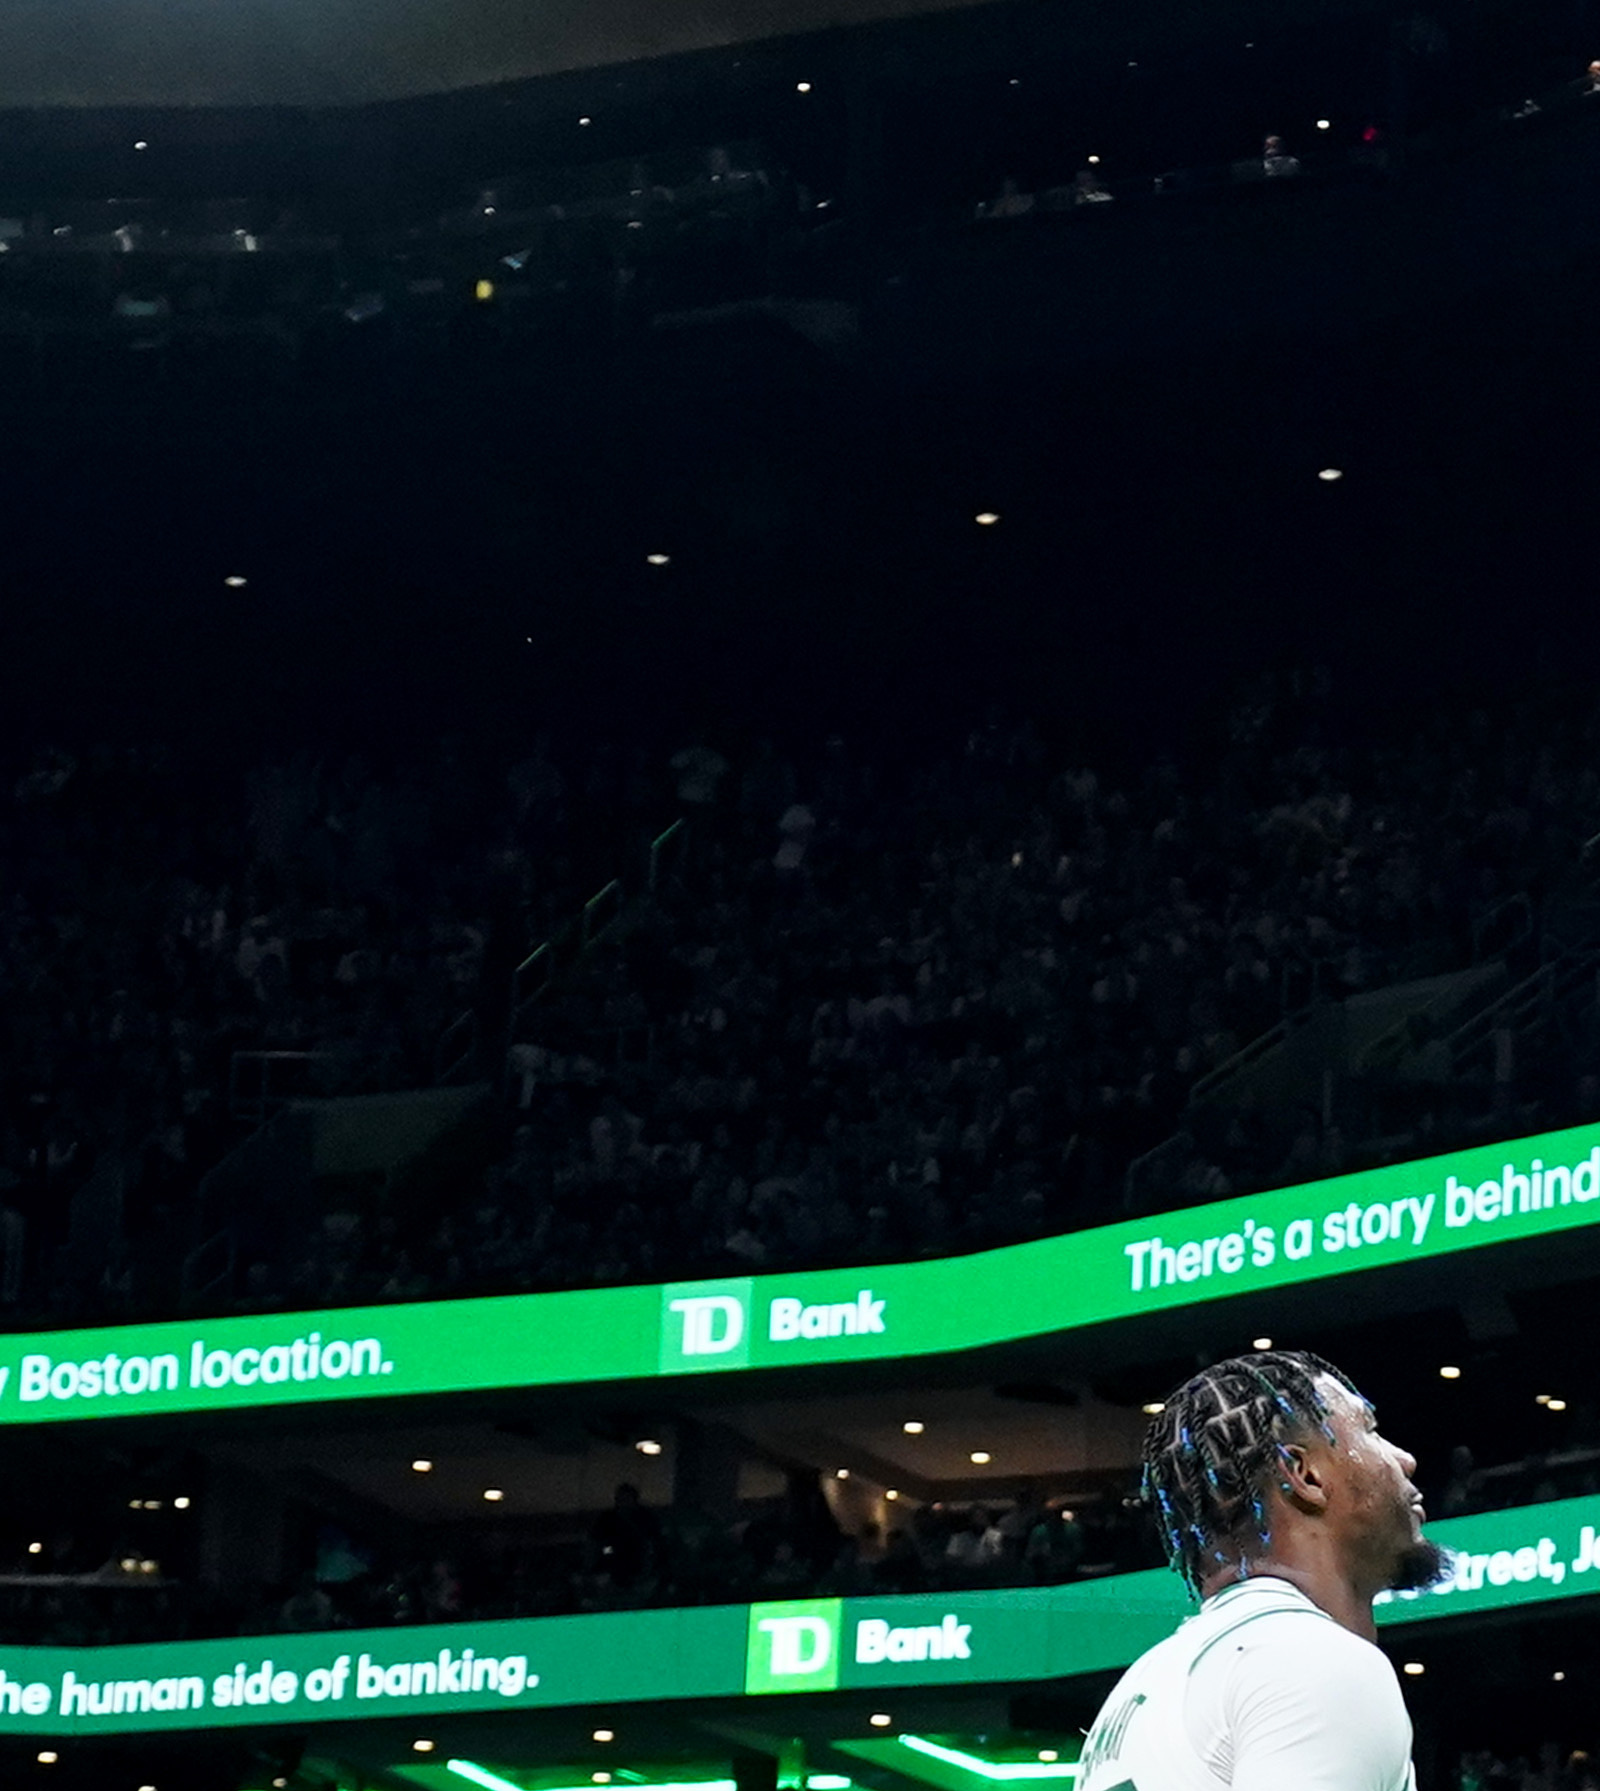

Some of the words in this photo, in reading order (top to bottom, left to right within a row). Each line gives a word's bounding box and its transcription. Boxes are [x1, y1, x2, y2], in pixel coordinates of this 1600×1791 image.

[1125, 1220, 1274, 1290] There's
[1285, 1220, 1312, 1259] a
[1323, 1195, 1434, 1251] story
[1446, 1147, 1600, 1226] behind
[670, 1295, 743, 1355] TD
[769, 1290, 885, 1342] Bank
[18, 1347, 179, 1404] Boston
[190, 1333, 394, 1392] location.
[759, 1616, 830, 1676] TD
[857, 1614, 971, 1664] Bank
[0, 1669, 52, 1716] he
[60, 1668, 203, 1717] human
[211, 1658, 294, 1710] side
[302, 1651, 351, 1703] of
[357, 1647, 541, 1709] banking.
